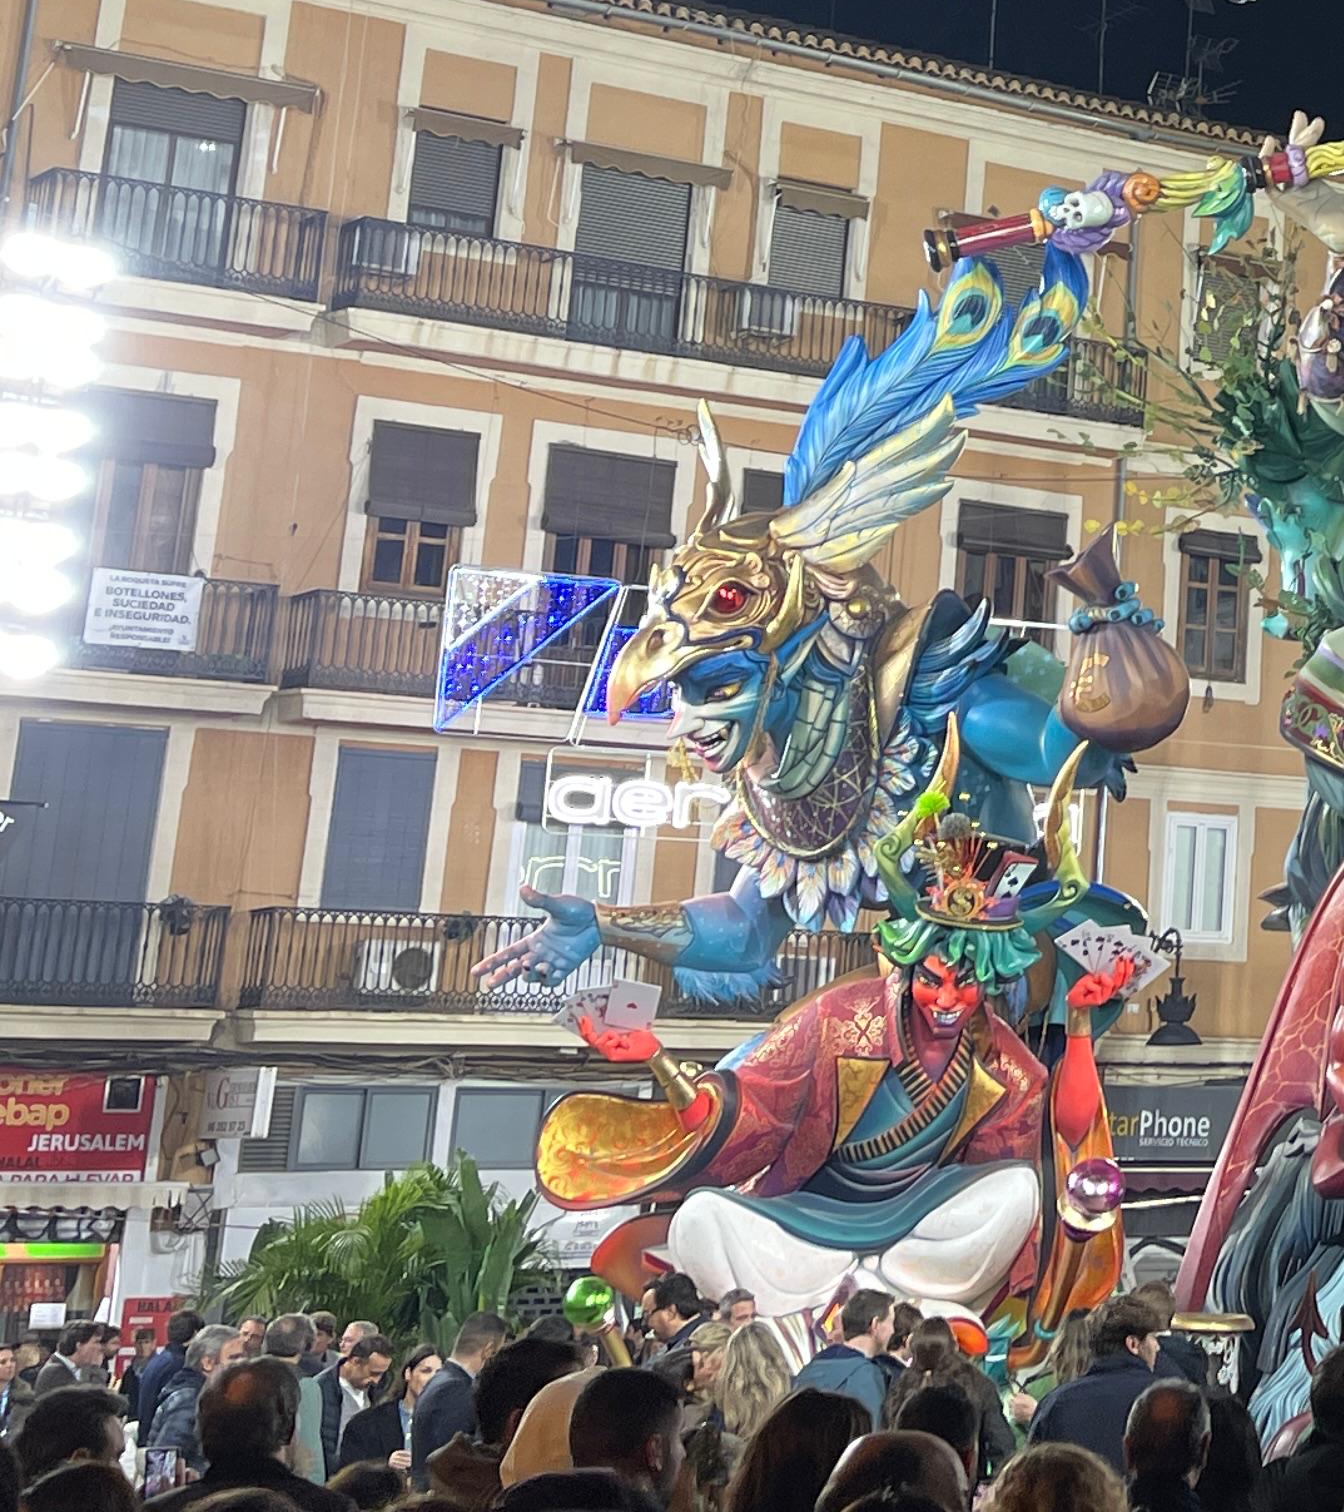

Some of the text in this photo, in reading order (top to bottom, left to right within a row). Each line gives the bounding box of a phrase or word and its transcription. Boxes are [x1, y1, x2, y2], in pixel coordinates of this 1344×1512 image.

[105, 586, 187, 603] BOTELLONES,
[112, 598, 175, 612] SUCIEDAD
[94, 608, 191, 625] E INSEGURIDAD.
[0, 1096, 70, 1131] bap
[27, 1133, 145, 1152] JERUSALEM
[1139, 1137, 1174, 1147] SERVICIO
